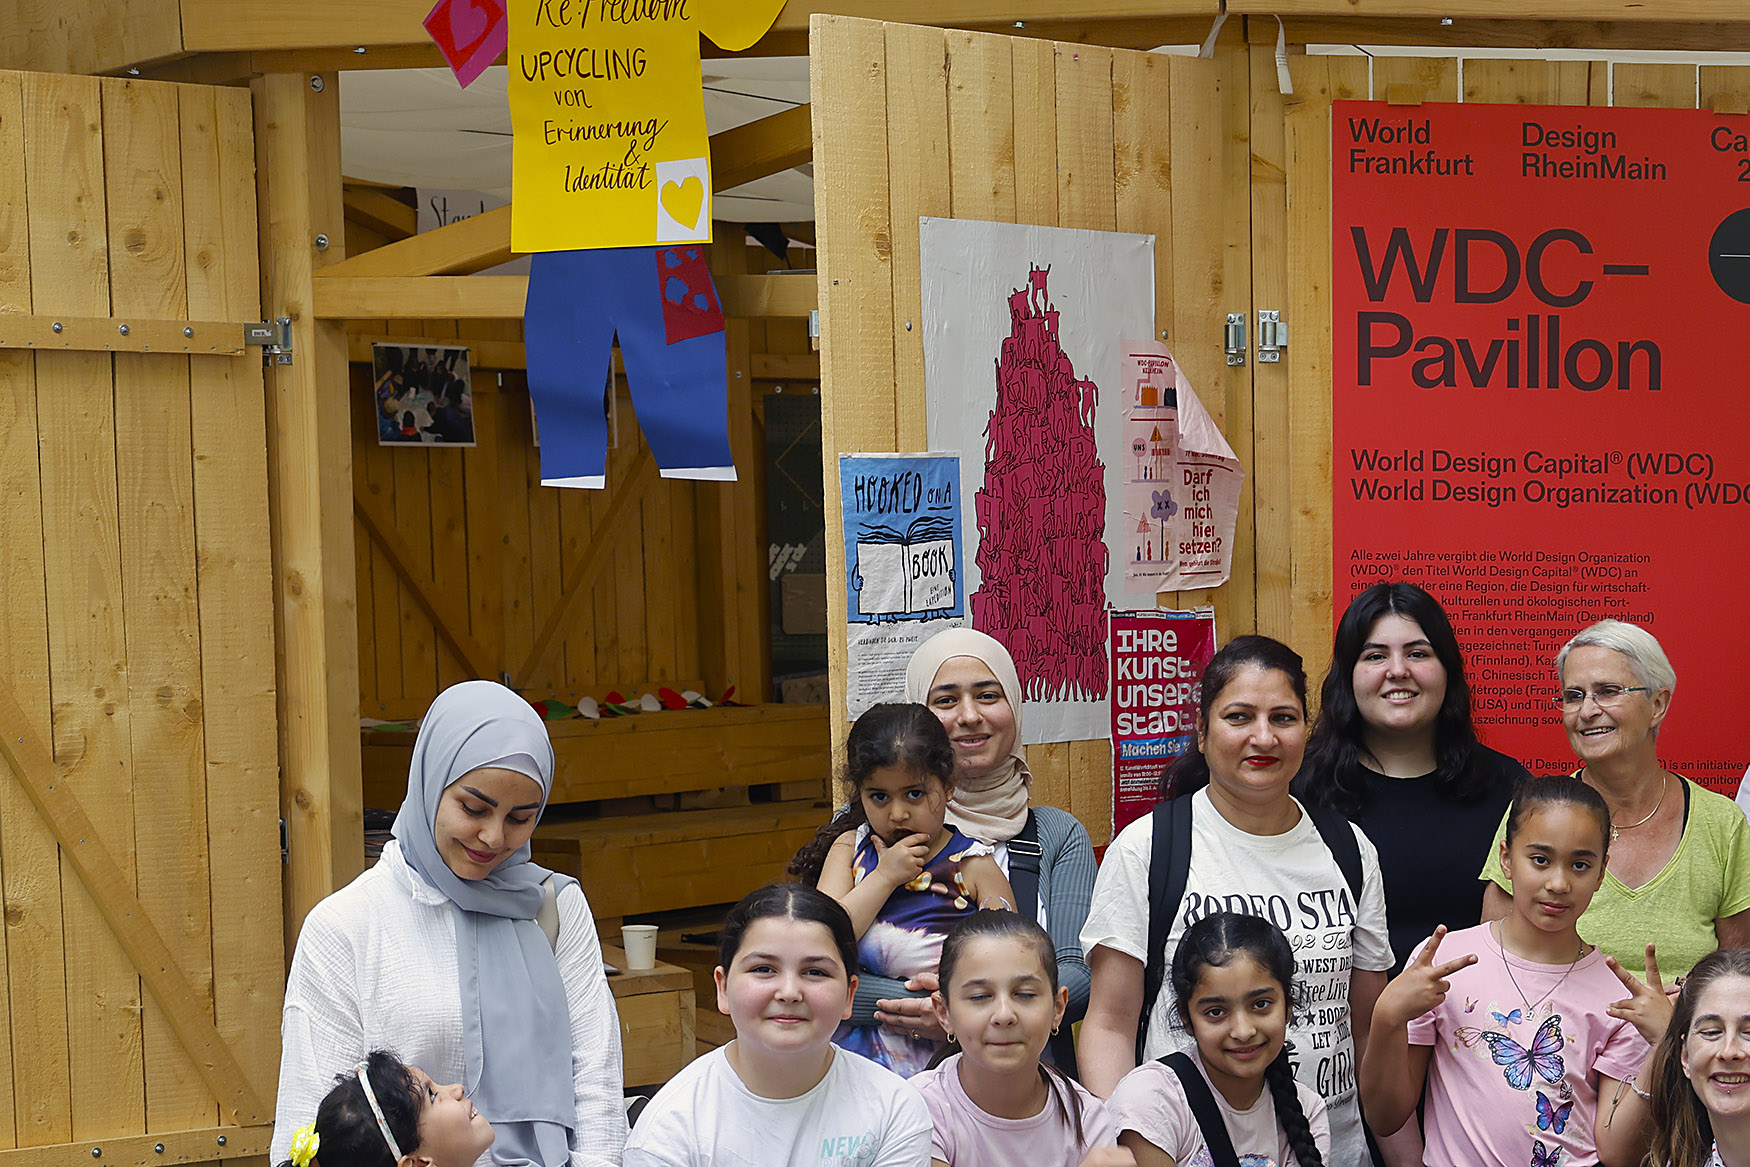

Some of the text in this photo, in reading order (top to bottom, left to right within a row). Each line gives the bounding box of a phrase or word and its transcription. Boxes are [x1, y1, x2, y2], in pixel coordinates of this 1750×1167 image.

[521, 47, 646, 81] UPCYCLING
[554, 88, 592, 108] von
[544, 118, 669, 151] Erinnerung
[1349, 118, 1431, 145] World
[1522, 122, 1617, 155] Design
[624, 139, 641, 167] &
[1349, 149, 1474, 176] Frankfurt
[1522, 153, 1667, 181] RheinMain
[564, 161, 652, 192] Identität
[1357, 311, 1662, 391] Pavillon
[1351, 448, 1424, 473] World
[1431, 450, 1517, 478] Design
[1627, 452, 1715, 479] (WDC)
[1183, 469, 1213, 486] Darf
[855, 472, 922, 514] HOOKED
[1192, 485, 1210, 501] ich
[1351, 478, 1424, 503] World
[1431, 479, 1517, 509] Design
[1523, 480, 1679, 509] Organization
[1184, 504, 1213, 520] mich
[1192, 522, 1215, 538] hier
[1179, 537, 1222, 555] setzen?
[913, 545, 948, 580] BOOK
[1351, 549, 1651, 566] Alle zwei Jahre vergibt die World Design Organization
[1402, 565, 1423, 576] den
[1426, 565, 1450, 577] Titel
[1452, 565, 1486, 577] World
[1489, 566, 1529, 579] Design
[1581, 567, 1623, 580] (WDC)
[1624, 570, 1638, 578] an
[1439, 581, 1463, 591] eine
[1465, 580, 1508, 594] Region,
[1510, 582, 1527, 592] die
[1530, 581, 1570, 594] Design
[1572, 582, 1588, 592] für
[1590, 582, 1651, 593] wirtschaft-
[1441, 595, 1631, 609] kulturellen und ökologischen Fort-
[1462, 609, 1512, 621] Frankfurt
[1515, 610, 1575, 622] RheinMain
[1474, 625, 1485, 636] in
[1487, 626, 1508, 636] den
[1533, 641, 1561, 651] Turin
[1471, 655, 1532, 668] (Finnland),
[1481, 670, 1546, 681] Chinesisch
[1525, 685, 1561, 698] (Frank
[1510, 700, 1531, 710] und
[1122, 742, 1166, 757] Machen
[1167, 739, 1180, 754] Sie
[1536, 759, 1575, 772] Design
[1669, 759, 1678, 770] is
[1681, 761, 1694, 770] an
[1697, 760, 1743, 770] initiative
[1689, 775, 1740, 788] cognition
[1298, 888, 1357, 930] STA
[1291, 935, 1316, 953] 92
[1303, 958, 1337, 974] WEST
[1327, 978, 1347, 1001] Live
